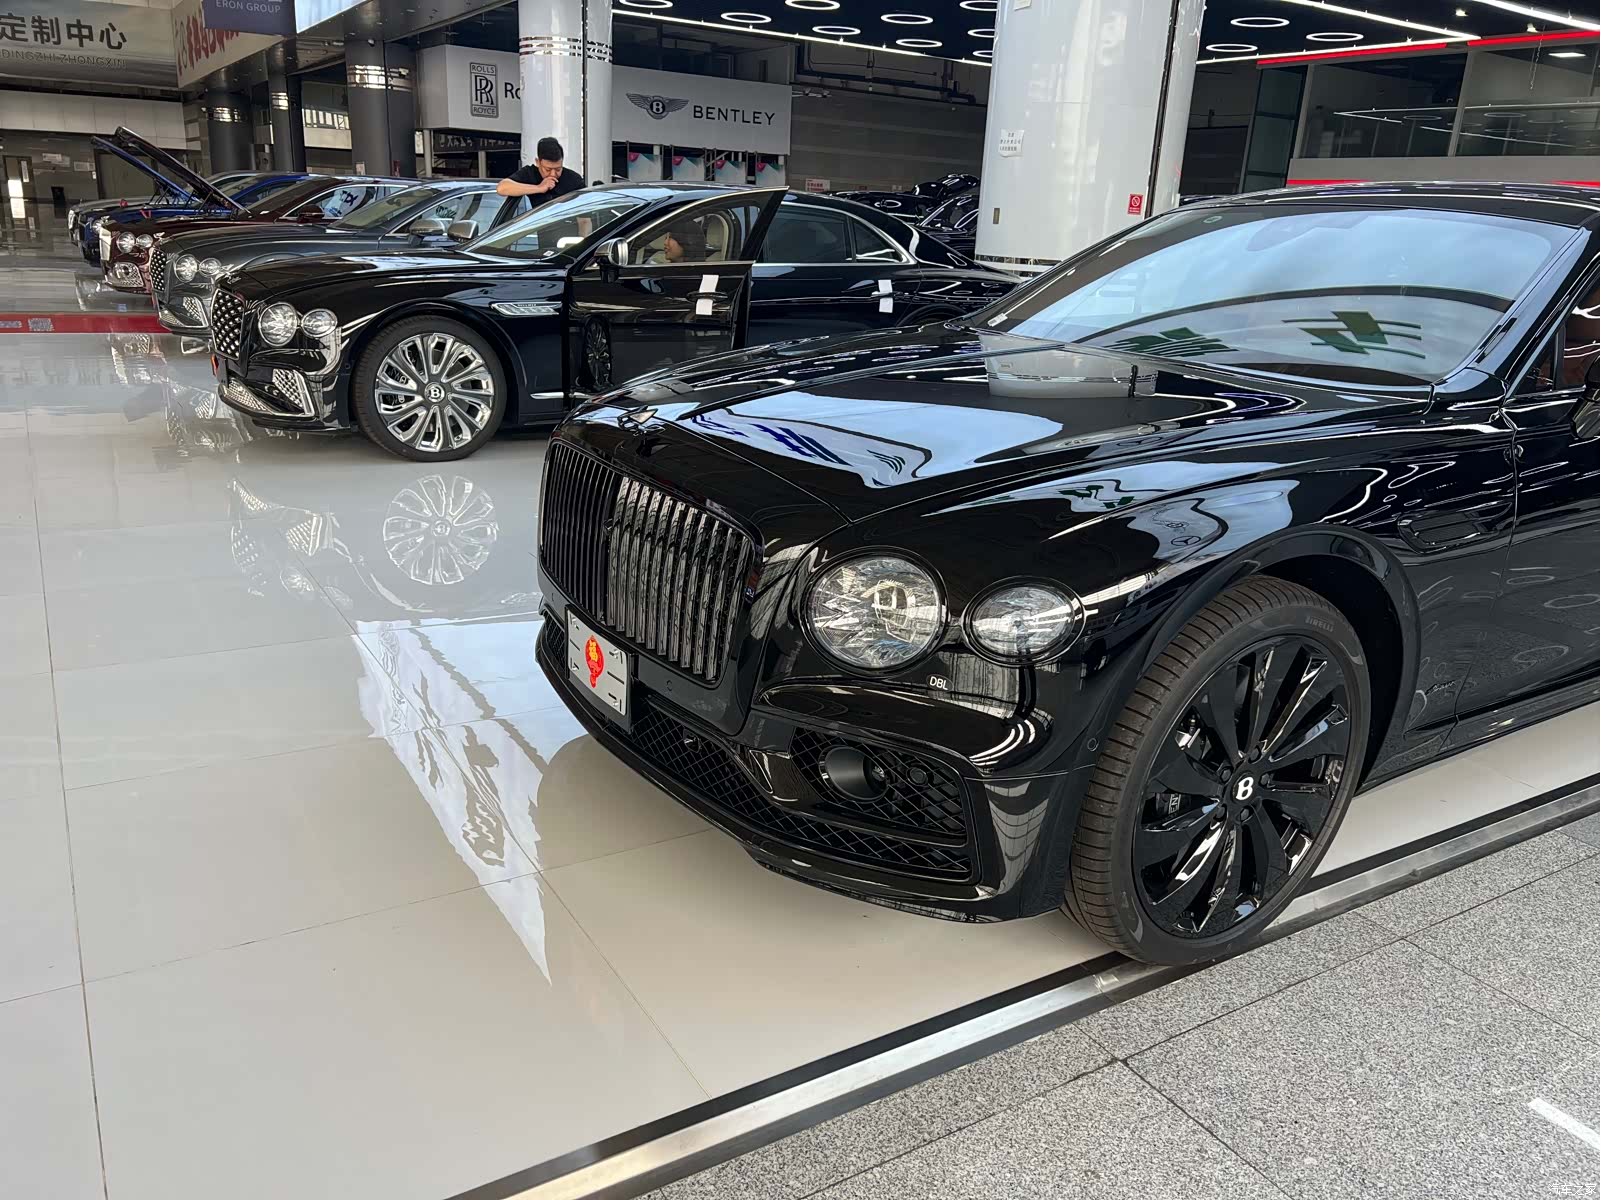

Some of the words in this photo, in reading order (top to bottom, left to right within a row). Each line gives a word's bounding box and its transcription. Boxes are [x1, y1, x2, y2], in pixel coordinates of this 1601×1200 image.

[216, 0, 243, 9] ERON
[246, 3, 281, 13] GROUP
[0, 13, 127, 50] 定制中心
[472, 65, 495, 73] ROLLS
[474, 107, 496, 115] ROYCE
[693, 105, 775, 125] BENTLEY
[430, 386, 440, 398] B
[930, 676, 948, 690] DBL
[1235, 776, 1254, 801] B
